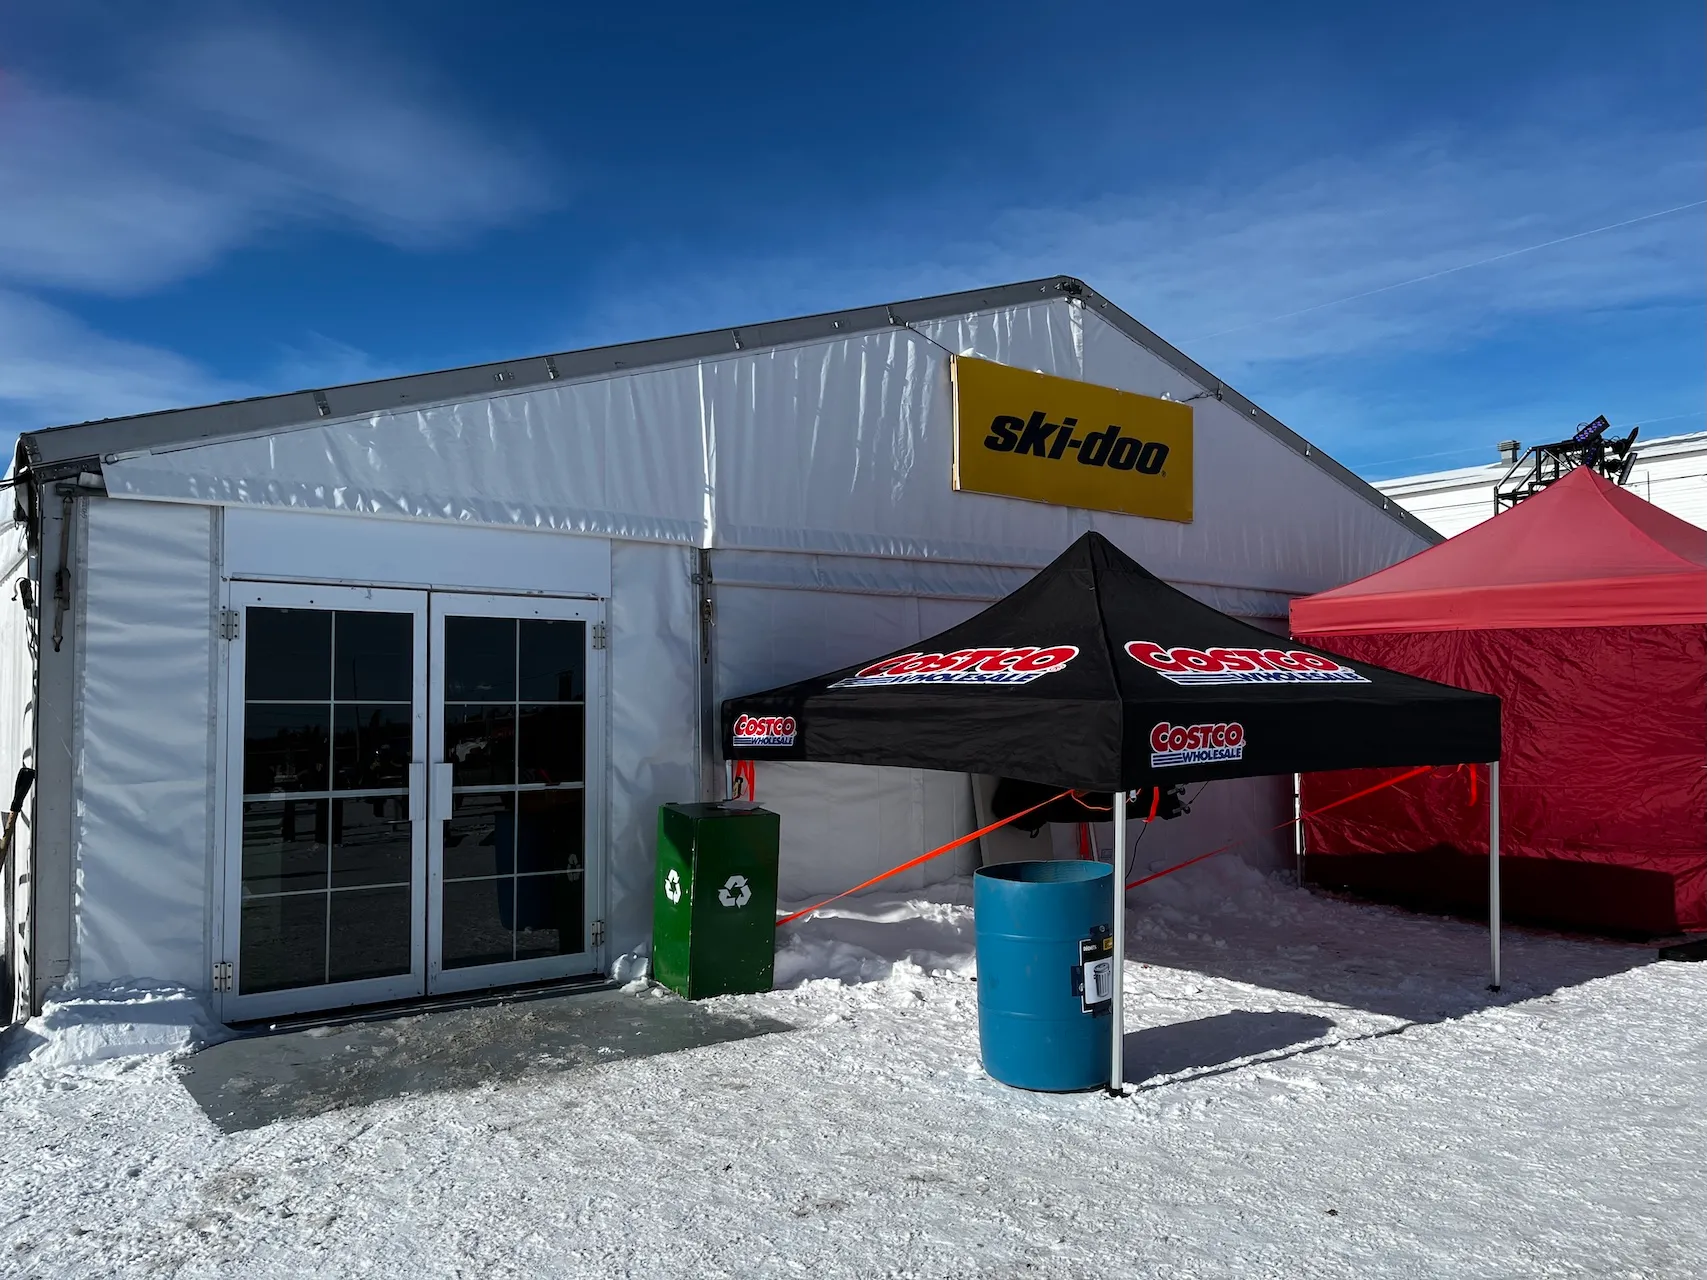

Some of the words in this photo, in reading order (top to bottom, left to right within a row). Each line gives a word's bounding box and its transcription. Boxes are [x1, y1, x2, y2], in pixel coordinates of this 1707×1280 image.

[984, 411, 1170, 475] ski-doo
[855, 646, 1079, 678] COSTCO
[1124, 641, 1340, 672] COSTCO
[891, 672, 1041, 684] WHOLESALE
[1234, 671, 1365, 682] WHOLESALE
[734, 714, 796, 736] COSTCO
[751, 736, 793, 745] WHOLESALE
[1150, 722, 1243, 752] COSTCO
[1181, 747, 1242, 763] WHOLESALE
